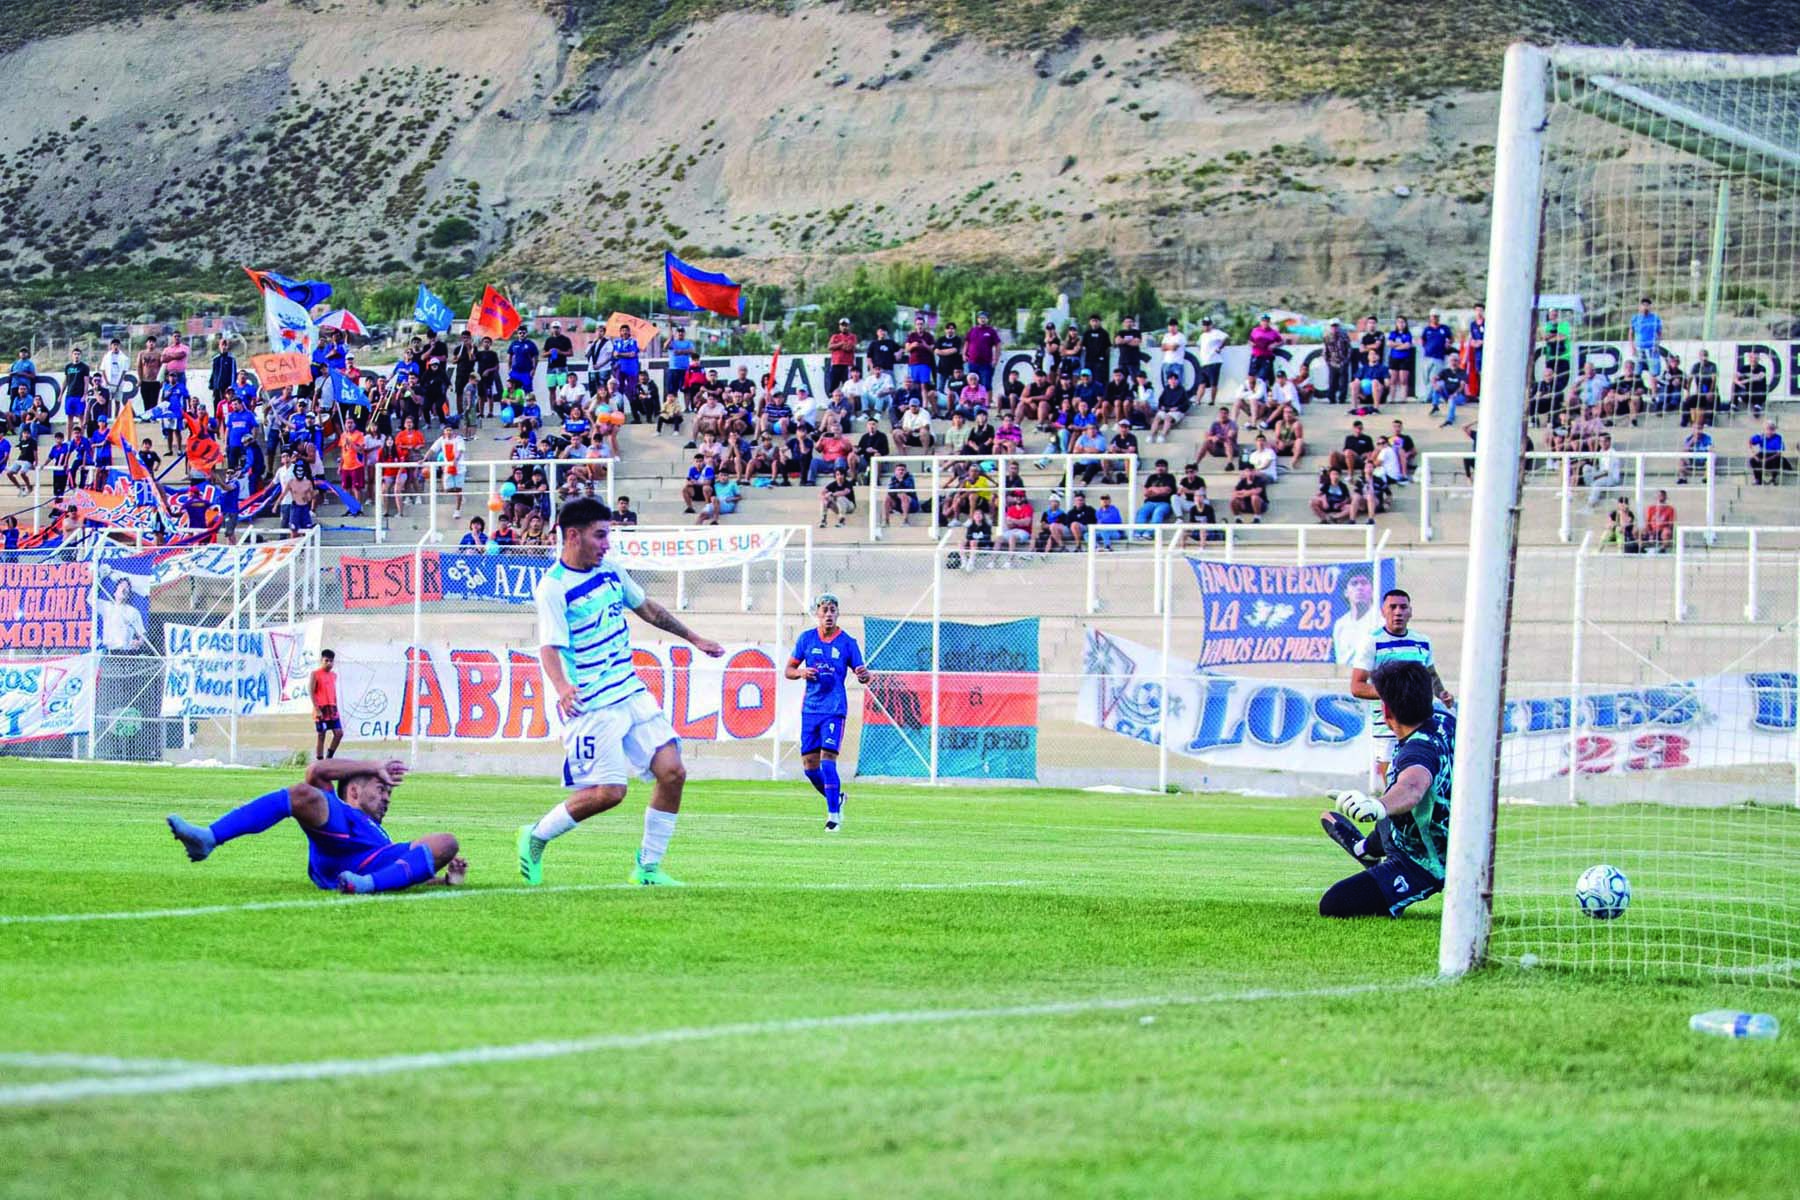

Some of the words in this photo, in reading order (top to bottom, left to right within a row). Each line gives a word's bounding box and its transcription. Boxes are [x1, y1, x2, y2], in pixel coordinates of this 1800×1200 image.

[264, 356, 297, 373] CAI
[620, 540, 648, 556] LOS
[651, 540, 695, 557] PIBES
[697, 538, 722, 555] DEL
[730, 533, 760, 552] SUR
[345, 564, 379, 600] EL
[384, 558, 440, 597] SUR
[494, 563, 548, 597] AZU
[1200, 562, 1258, 594] AMOR
[1261, 566, 1338, 594] ETERNO
[24, 588, 87, 619] GLORIA
[1209, 600, 1241, 632] LA
[1298, 600, 1333, 630] 23
[168, 627, 192, 653] LA
[197, 632, 264, 657] PASON
[1200, 638, 1254, 665] VAMOS
[1252, 637, 1283, 661] LOS
[360, 720, 390, 737] CAI
[1188, 680, 1367, 752] LOS
[575, 736, 596, 760] 15
[1551, 733, 1691, 777] 23
